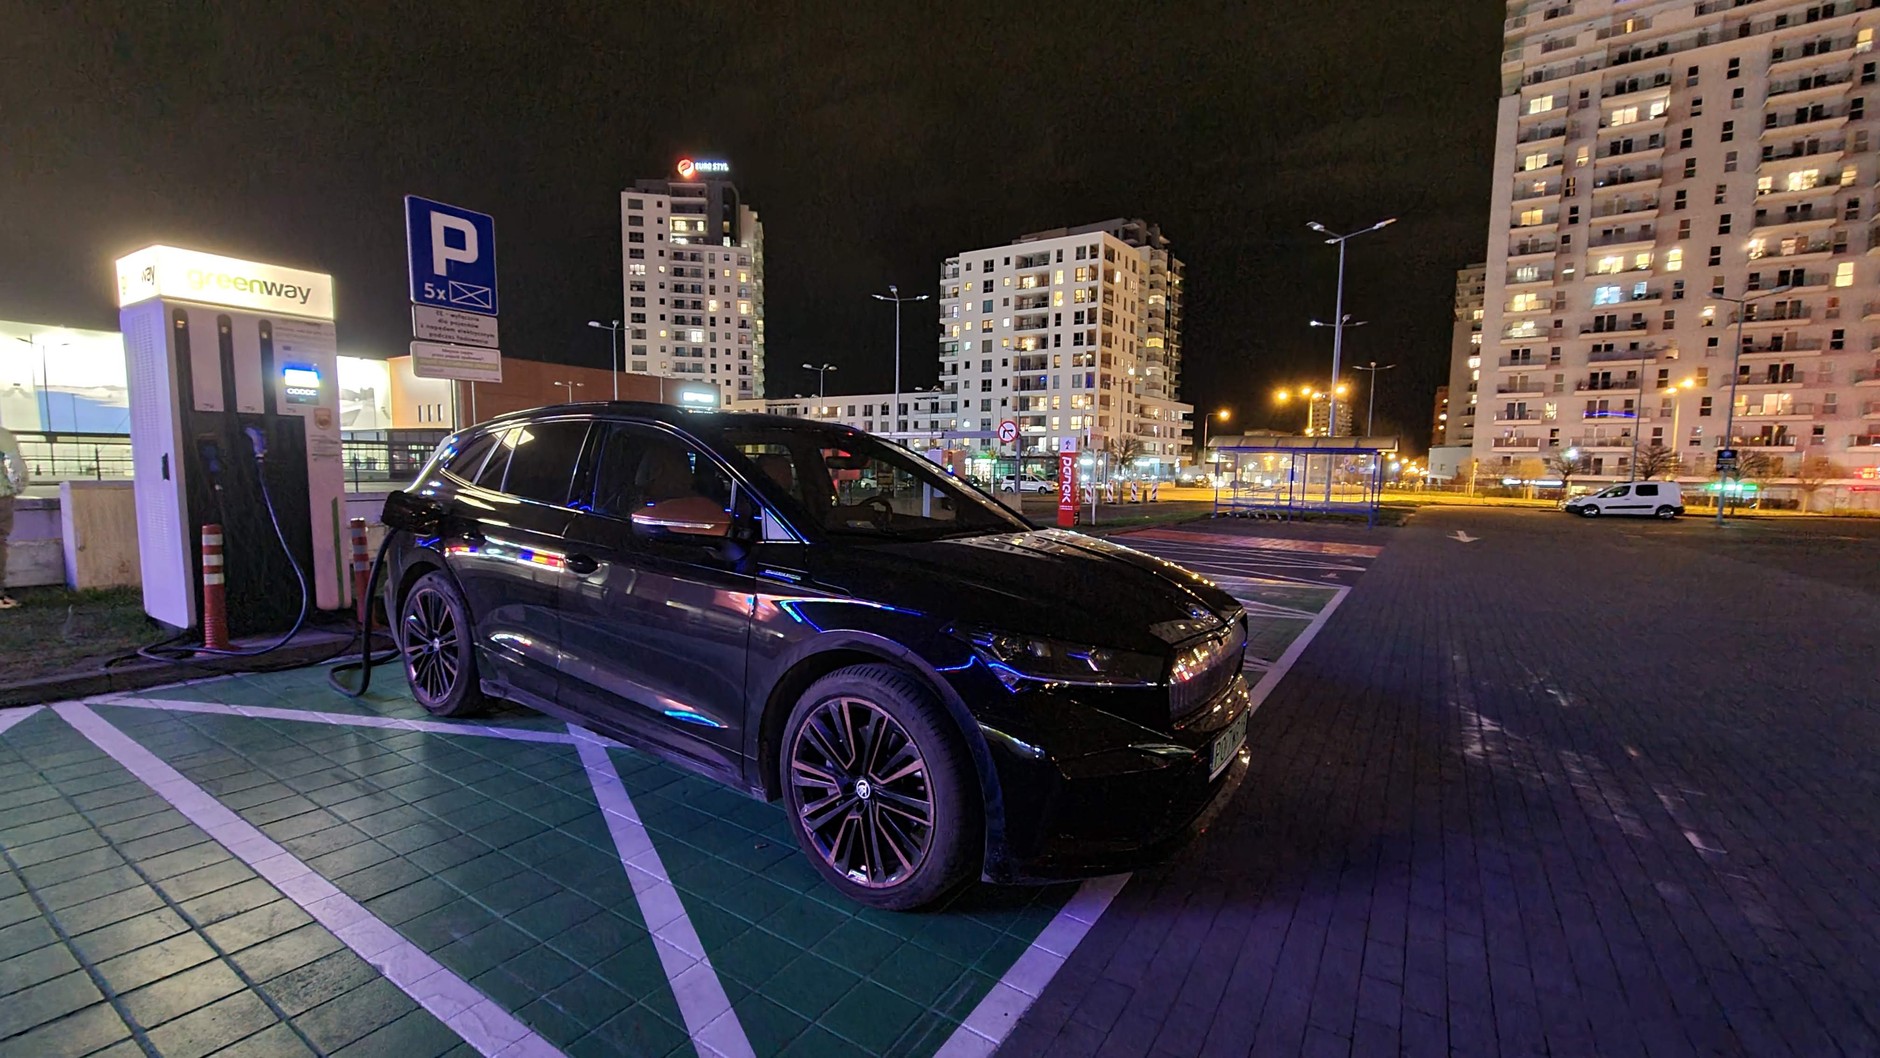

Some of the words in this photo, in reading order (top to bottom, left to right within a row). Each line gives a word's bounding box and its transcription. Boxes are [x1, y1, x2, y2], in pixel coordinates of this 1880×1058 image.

[430, 210, 478, 276] P
[187, 268, 311, 304] greenway
[424, 283, 447, 301] 5x
[1062, 456, 1072, 503] panek
